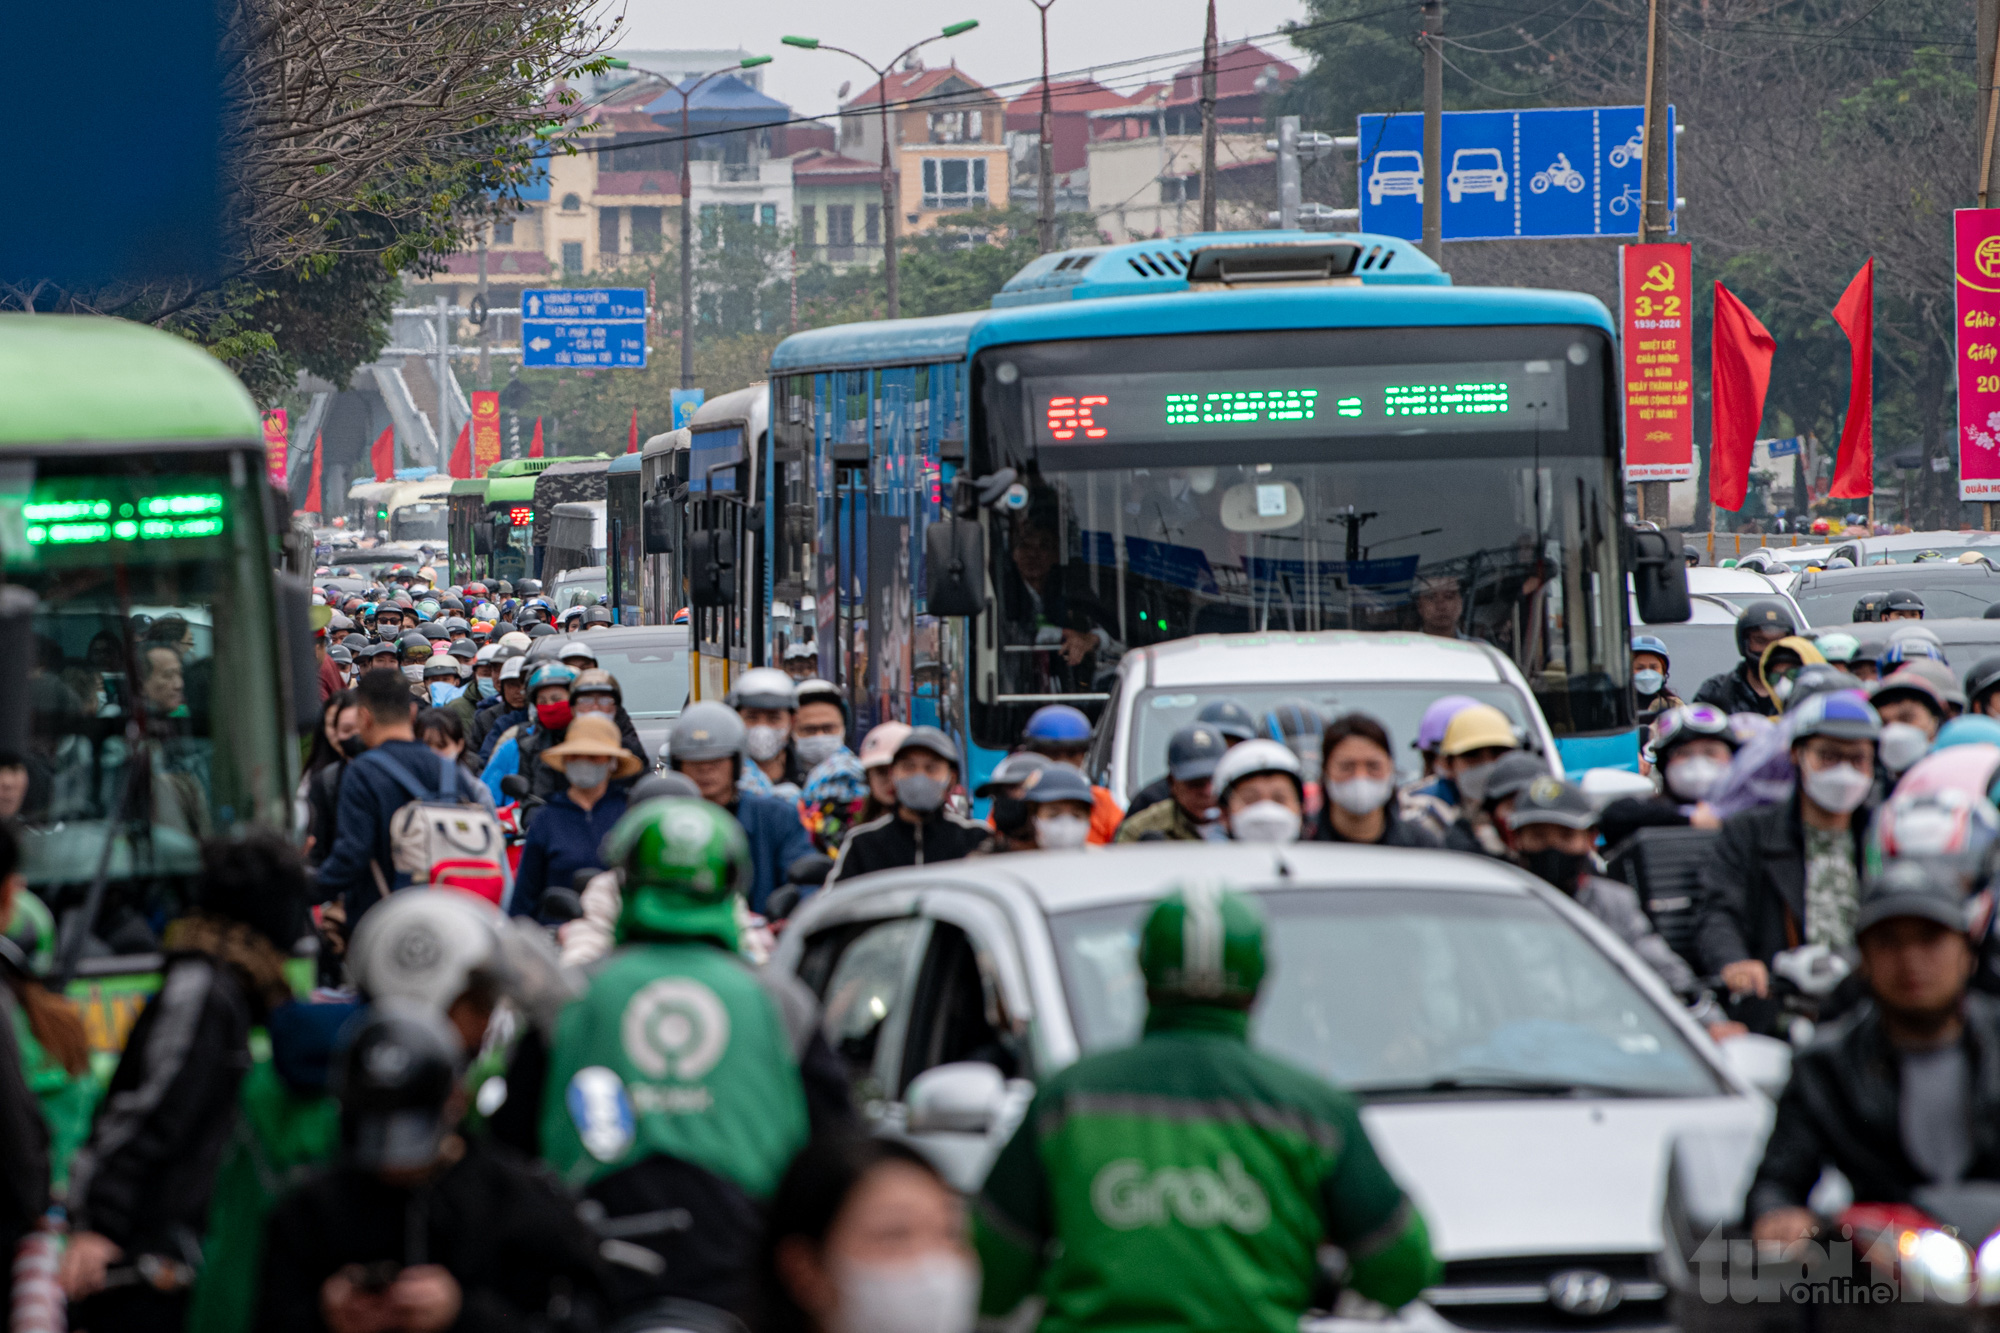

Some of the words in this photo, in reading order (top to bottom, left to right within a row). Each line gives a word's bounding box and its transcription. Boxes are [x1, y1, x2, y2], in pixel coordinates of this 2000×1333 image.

[1634, 295, 1681, 317] 3-2
[1634, 319, 1681, 329] 1930-2024
[1964, 310, 1996, 328] Chào
[1967, 343, 1998, 364] Giáp
[1965, 484, 1989, 495] QUẬN
[1090, 1150, 1273, 1236] Grab
